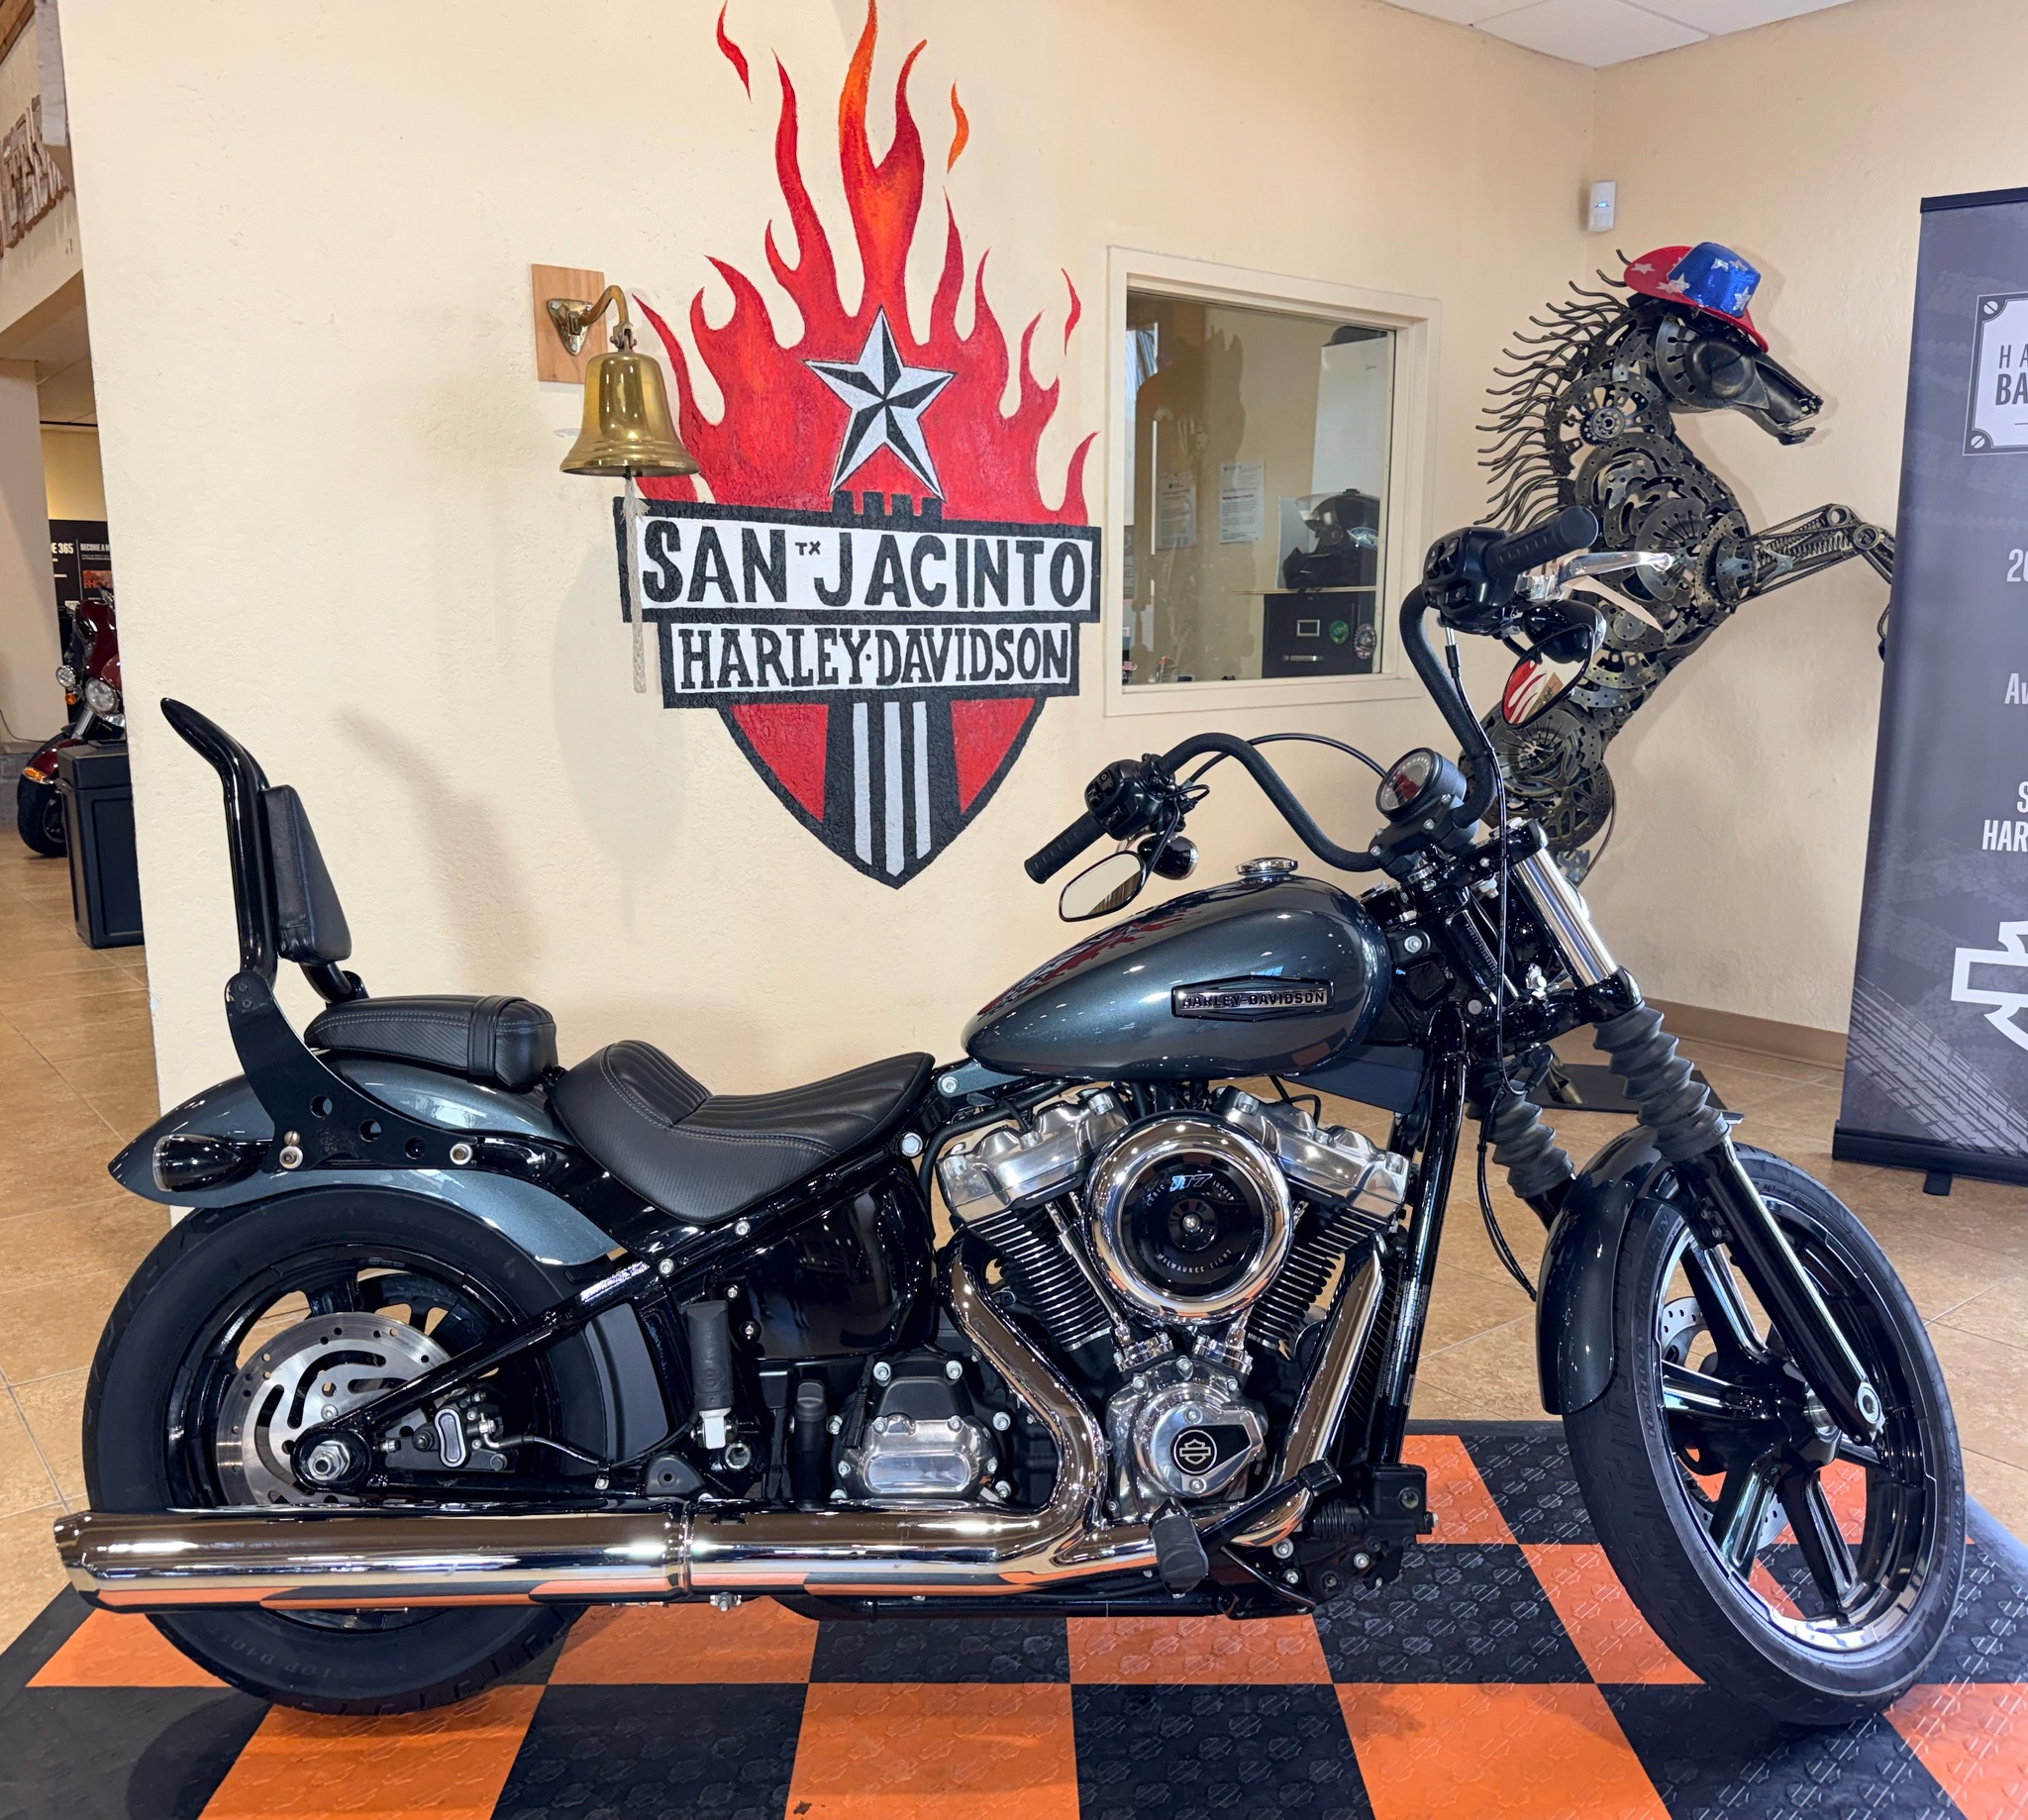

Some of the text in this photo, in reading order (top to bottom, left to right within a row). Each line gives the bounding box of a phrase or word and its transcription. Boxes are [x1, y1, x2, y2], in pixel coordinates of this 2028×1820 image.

[1994, 372, 2028, 406] BA
[58, 543, 74, 554] 365
[643, 520, 1086, 609] SAN TX JACINTO
[1981, 819, 2028, 853] HAR
[1182, 991, 1324, 1009] HARLEY-DAVIDSON
[1146, 1183, 1166, 1207] CUBIC
[1212, 1179, 1235, 1201] INCHES
